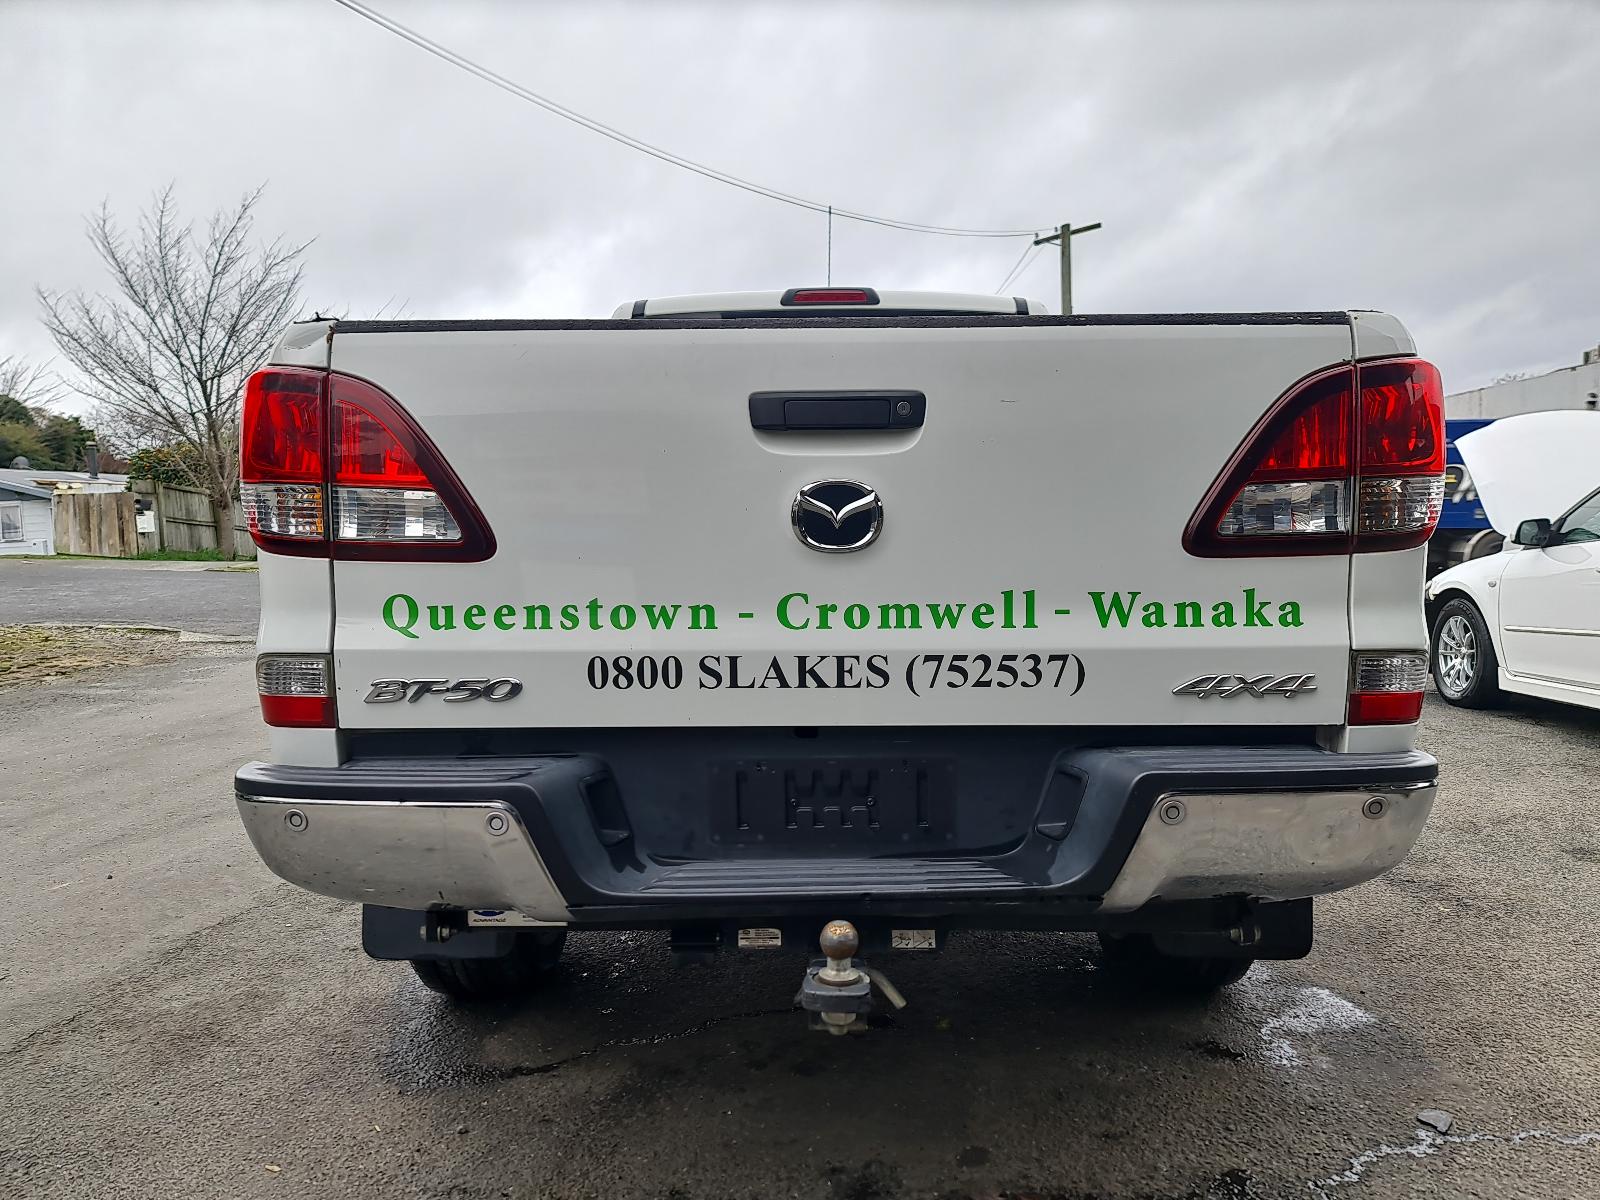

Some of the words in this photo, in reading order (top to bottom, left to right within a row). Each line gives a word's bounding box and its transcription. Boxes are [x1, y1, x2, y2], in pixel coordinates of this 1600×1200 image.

[382, 593, 718, 639] Queenstown
[738, 611, 754, 619] -
[776, 590, 1039, 631] Cromwell
[1088, 588, 1304, 629] Wanaka
[363, 677, 523, 704] BT-50
[587, 655, 683, 690] 0800
[699, 654, 890, 690] SLAKES
[905, 653, 1086, 697] (752537)
